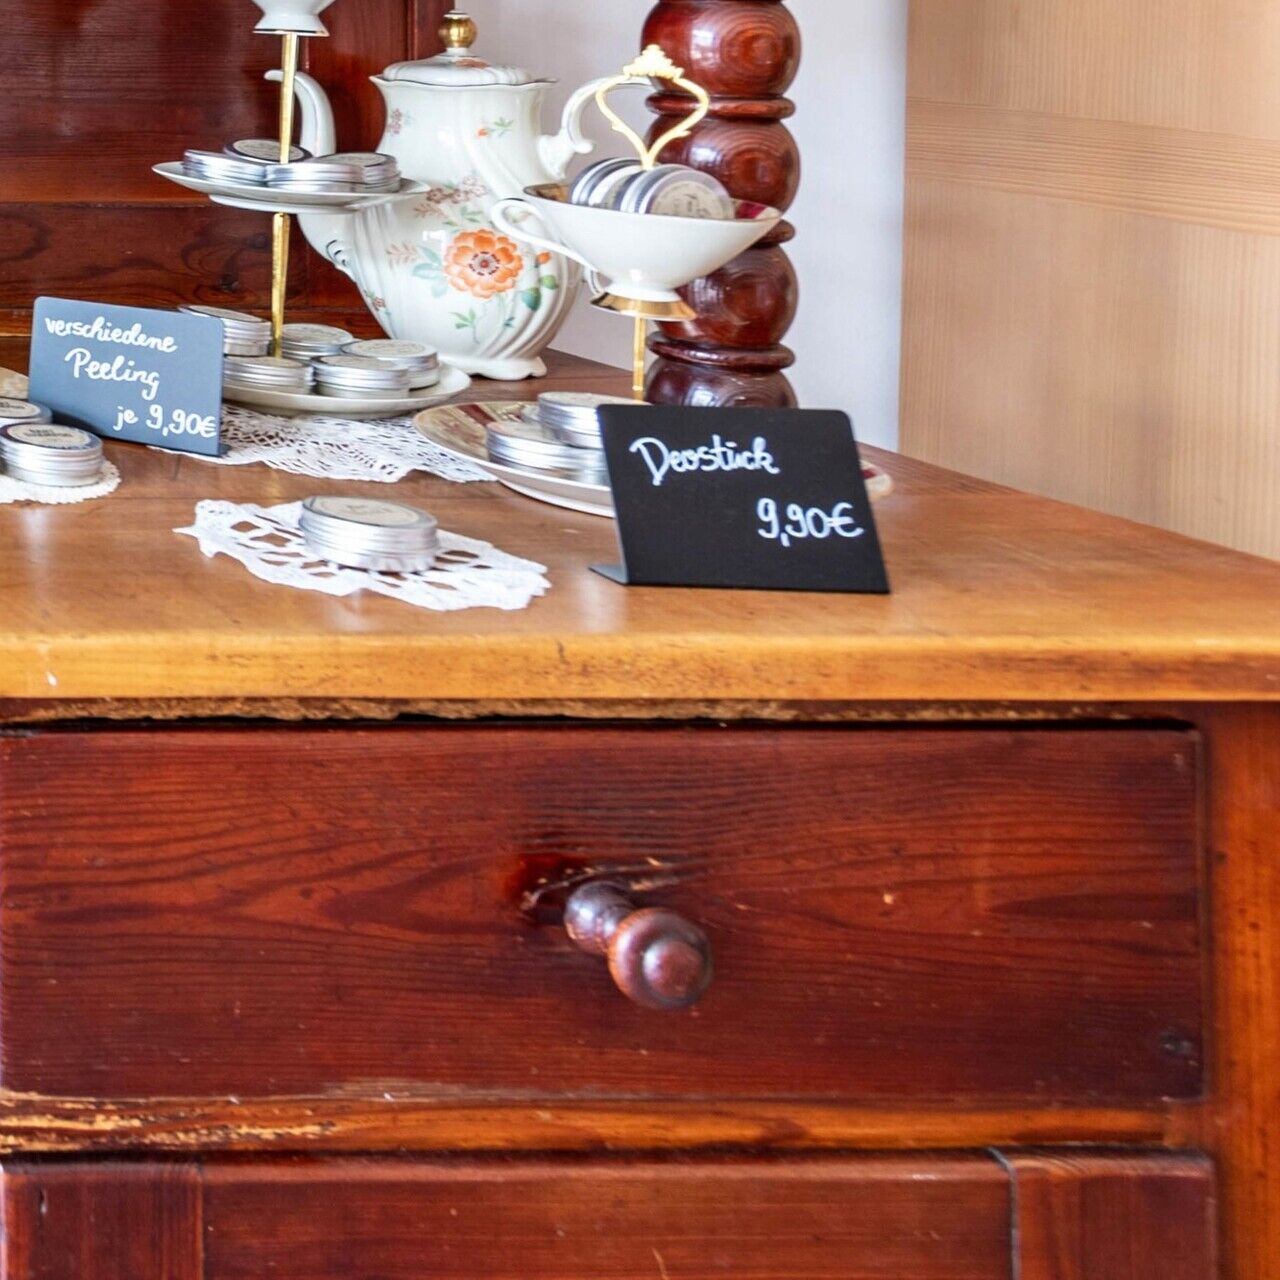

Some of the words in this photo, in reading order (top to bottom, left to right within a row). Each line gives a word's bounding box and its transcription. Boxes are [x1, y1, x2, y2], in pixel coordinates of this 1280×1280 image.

[44, 315, 178, 354] verschiedene
[64, 347, 161, 400] Peeling
[112, 406, 137, 432] je
[145, 406, 218, 438] 9,90€
[629, 431, 781, 487] Deostück
[756, 497, 866, 549] 9,90€
